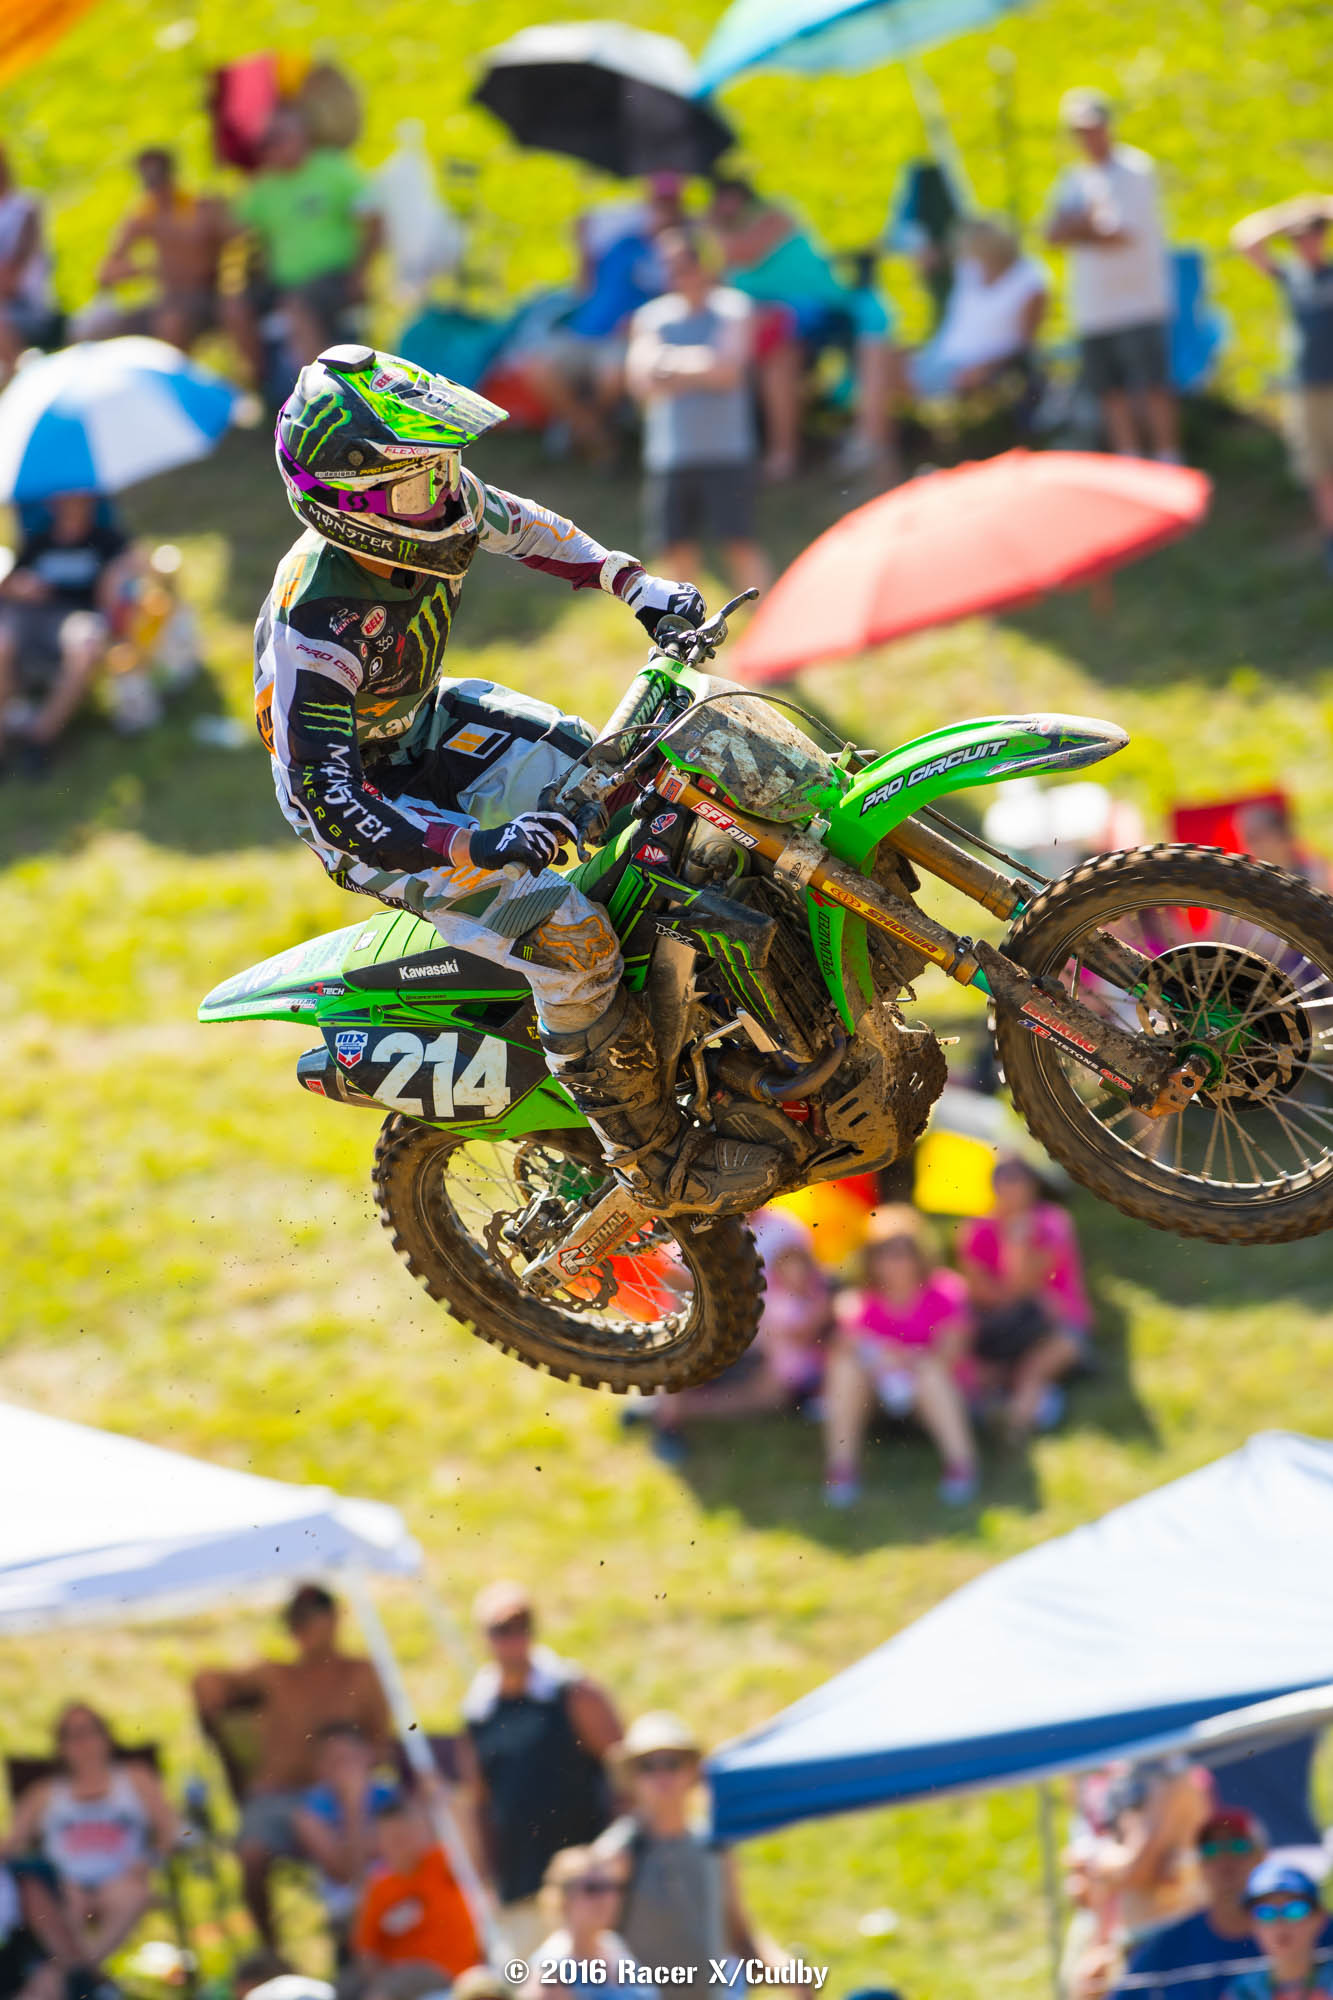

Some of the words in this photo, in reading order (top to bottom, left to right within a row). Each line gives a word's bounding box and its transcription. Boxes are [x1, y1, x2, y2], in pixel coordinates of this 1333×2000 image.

[308, 504, 394, 552] MONSTER
[364, 612, 384, 634] BELL
[296, 644, 334, 661] PRO
[860, 775, 904, 816] PRO
[907, 738, 1010, 788] CIRCUIT
[696, 803, 734, 829] SFF
[727, 827, 759, 849] AIR
[817, 911, 836, 979] SPECIALIZED
[399, 959, 459, 980] Kawasaki
[371, 1032, 511, 1118] 214
[1048, 1036, 1100, 1069] PISTONS
